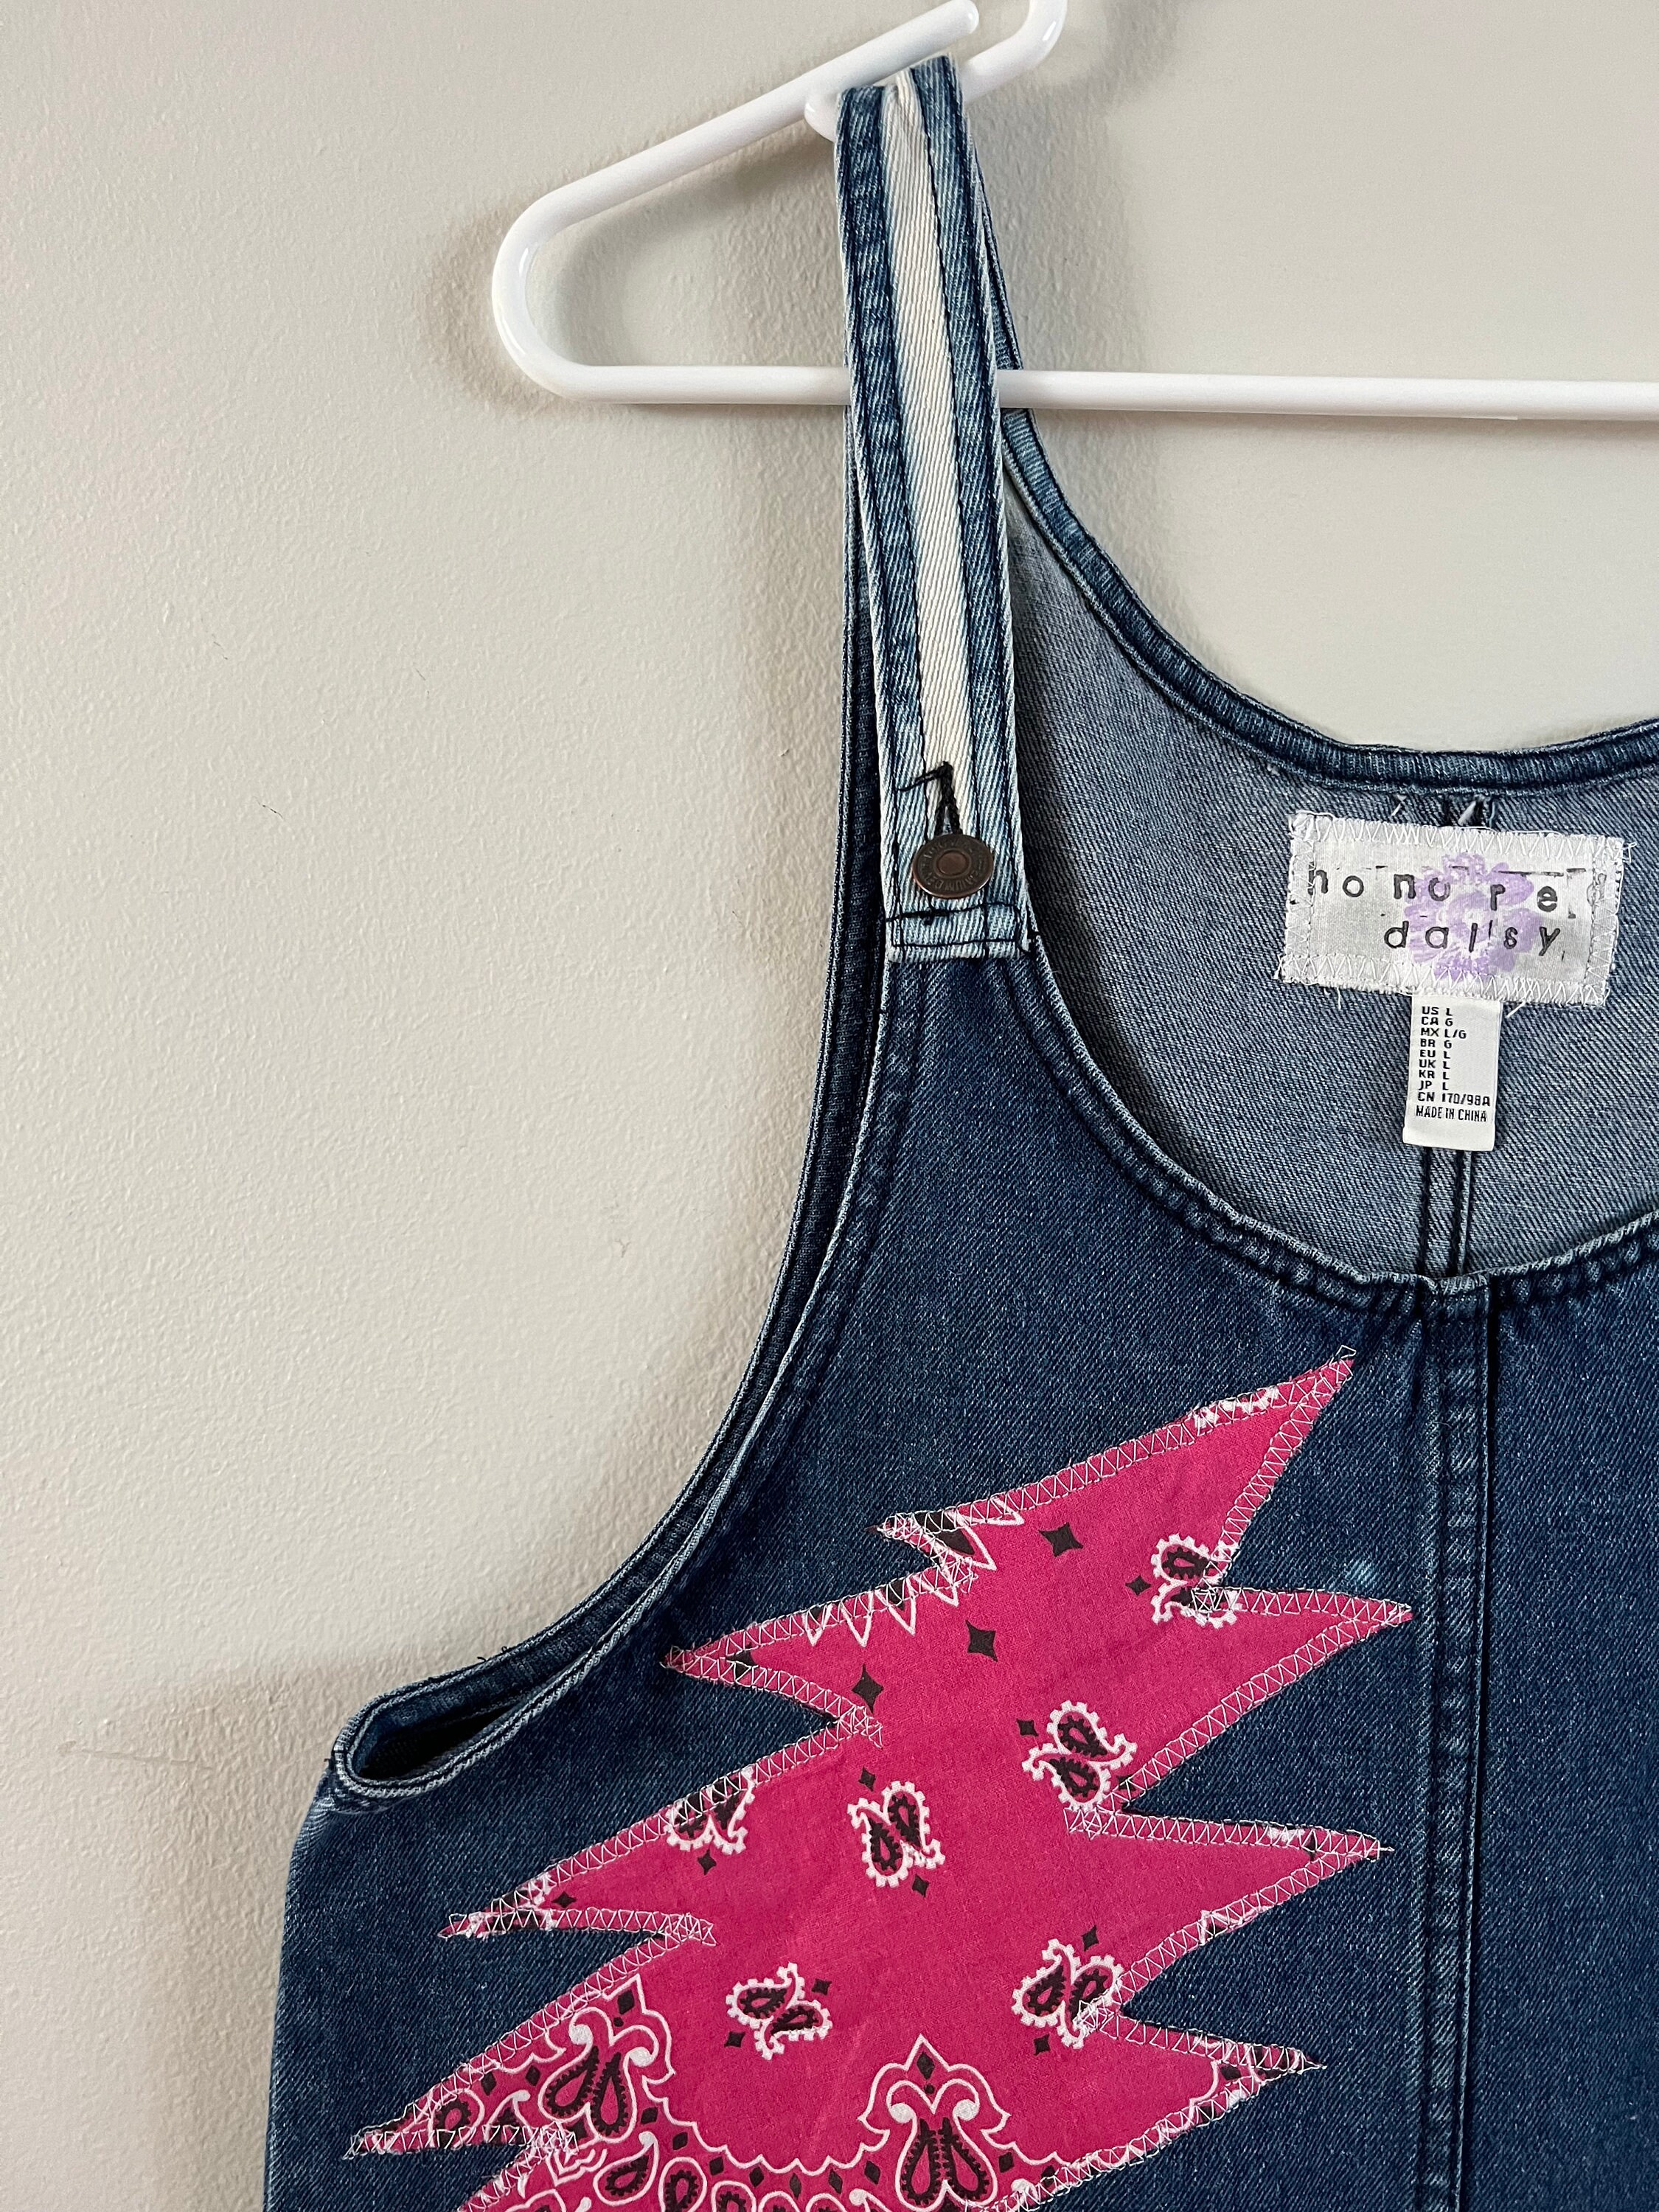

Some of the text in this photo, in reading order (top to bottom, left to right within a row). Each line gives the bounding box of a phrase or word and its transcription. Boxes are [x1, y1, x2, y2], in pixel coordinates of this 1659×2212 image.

[1422, 1006, 1453, 1016] US L
[1421, 1017, 1453, 1026] CA G
[1421, 1028, 1467, 1039] MX L/G
[1420, 1039, 1452, 1048] BR G
[1419, 1060, 1450, 1069] UK L
[1419, 1070, 1435, 1079] KR
[1419, 1081, 1432, 1090] JP
[1418, 1092, 1490, 1106] CN 170/98A
[1416, 1106, 1486, 1121] MADE IN CHINA
